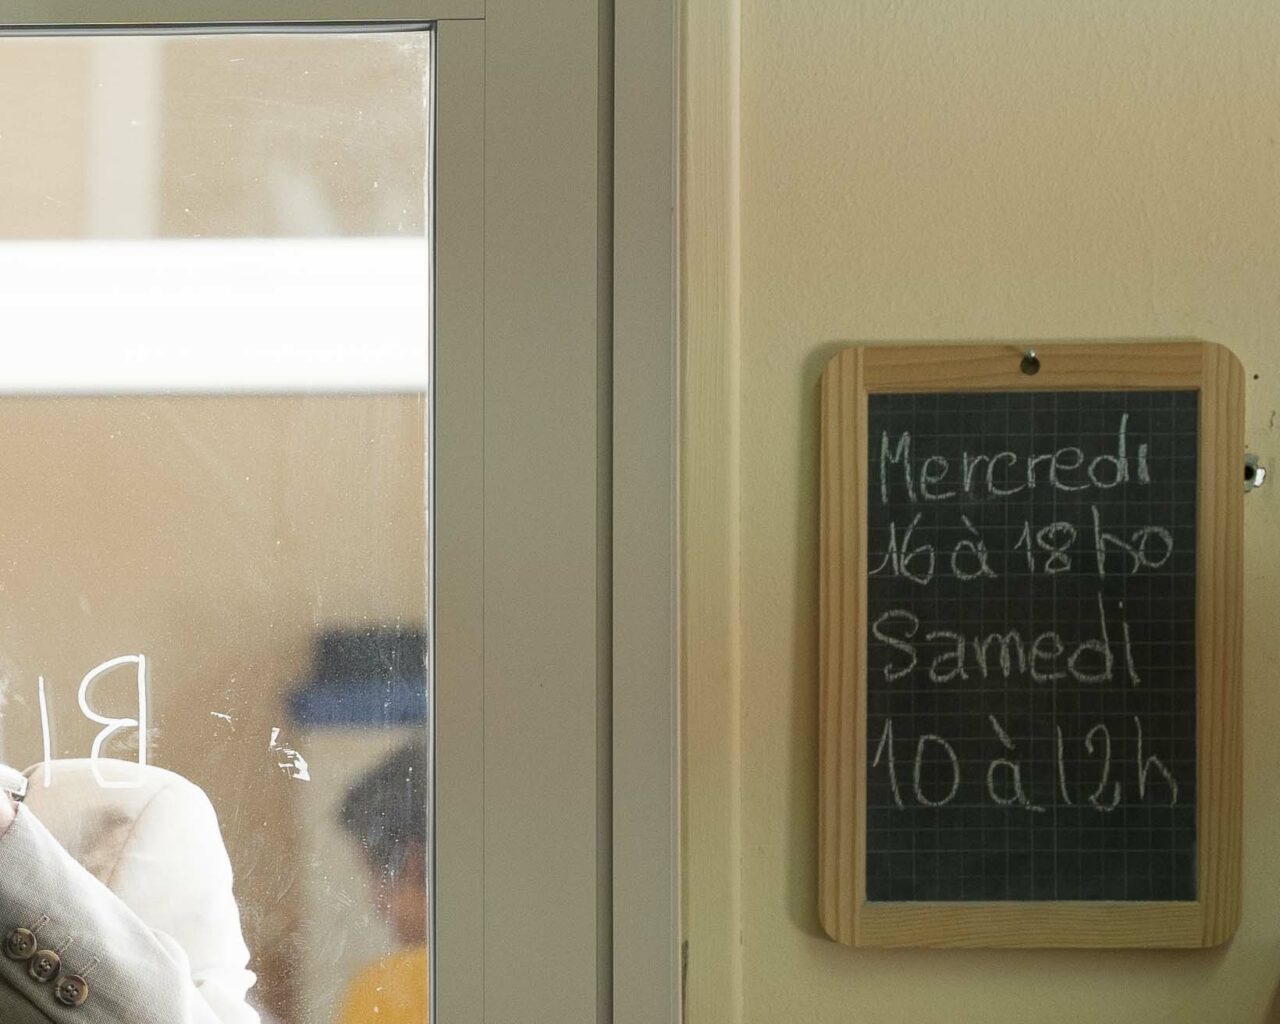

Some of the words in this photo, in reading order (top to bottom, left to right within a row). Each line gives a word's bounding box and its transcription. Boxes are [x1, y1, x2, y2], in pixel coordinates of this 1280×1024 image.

[880, 413, 1150, 502] Mercredi
[869, 512, 936, 584] 16
[951, 515, 998, 580] à
[872, 592, 1141, 688] Samedi
[874, 717, 960, 810] 10
[986, 714, 1046, 813] à
